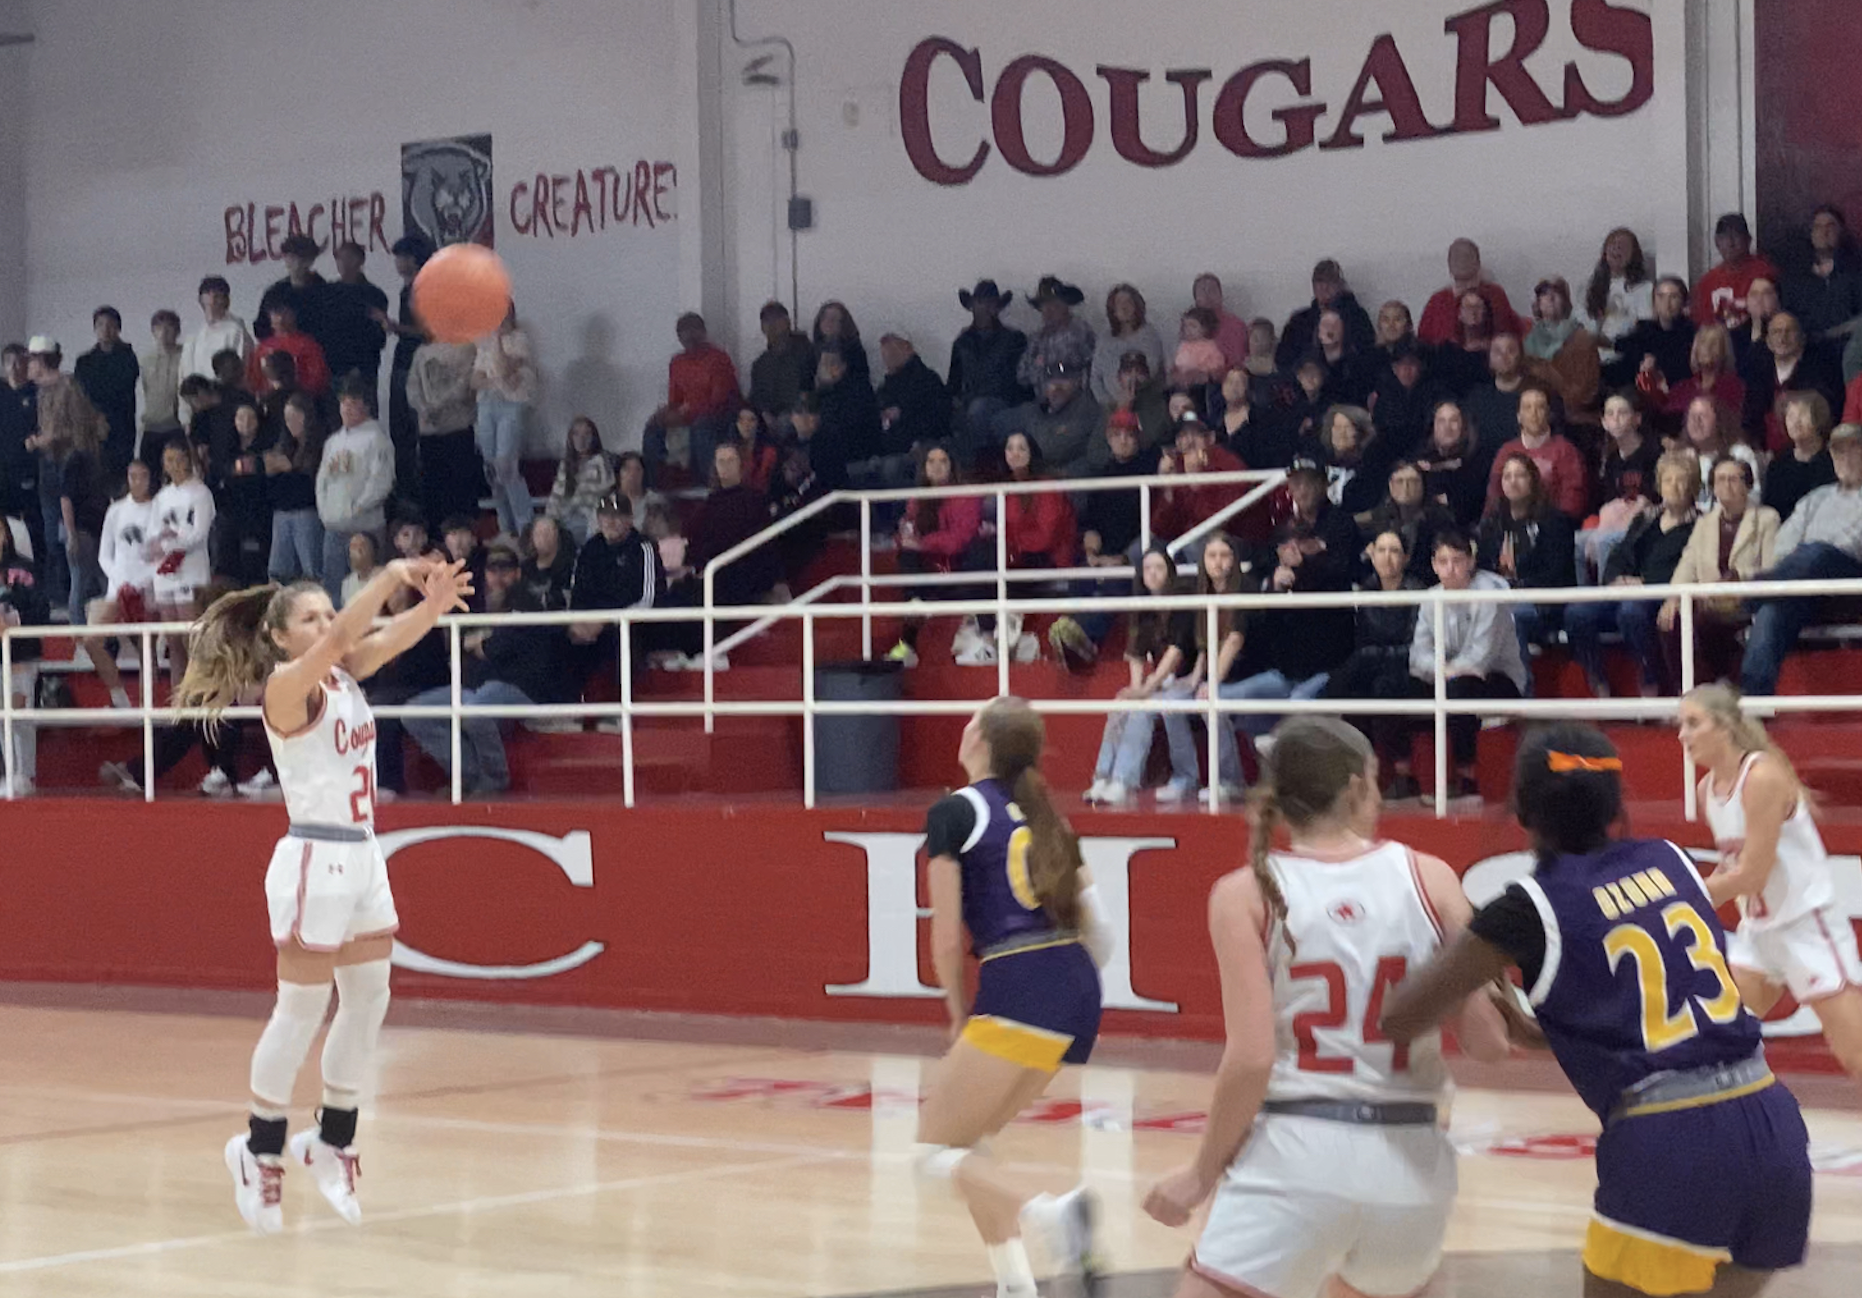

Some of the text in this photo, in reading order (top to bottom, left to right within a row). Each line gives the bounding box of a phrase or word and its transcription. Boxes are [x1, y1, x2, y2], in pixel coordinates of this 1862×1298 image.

[900, 0, 1654, 186] COUGARS
[510, 160, 678, 239] CREATURE
[1289, 955, 1407, 1074] 24
[1602, 901, 1740, 1053] 23
